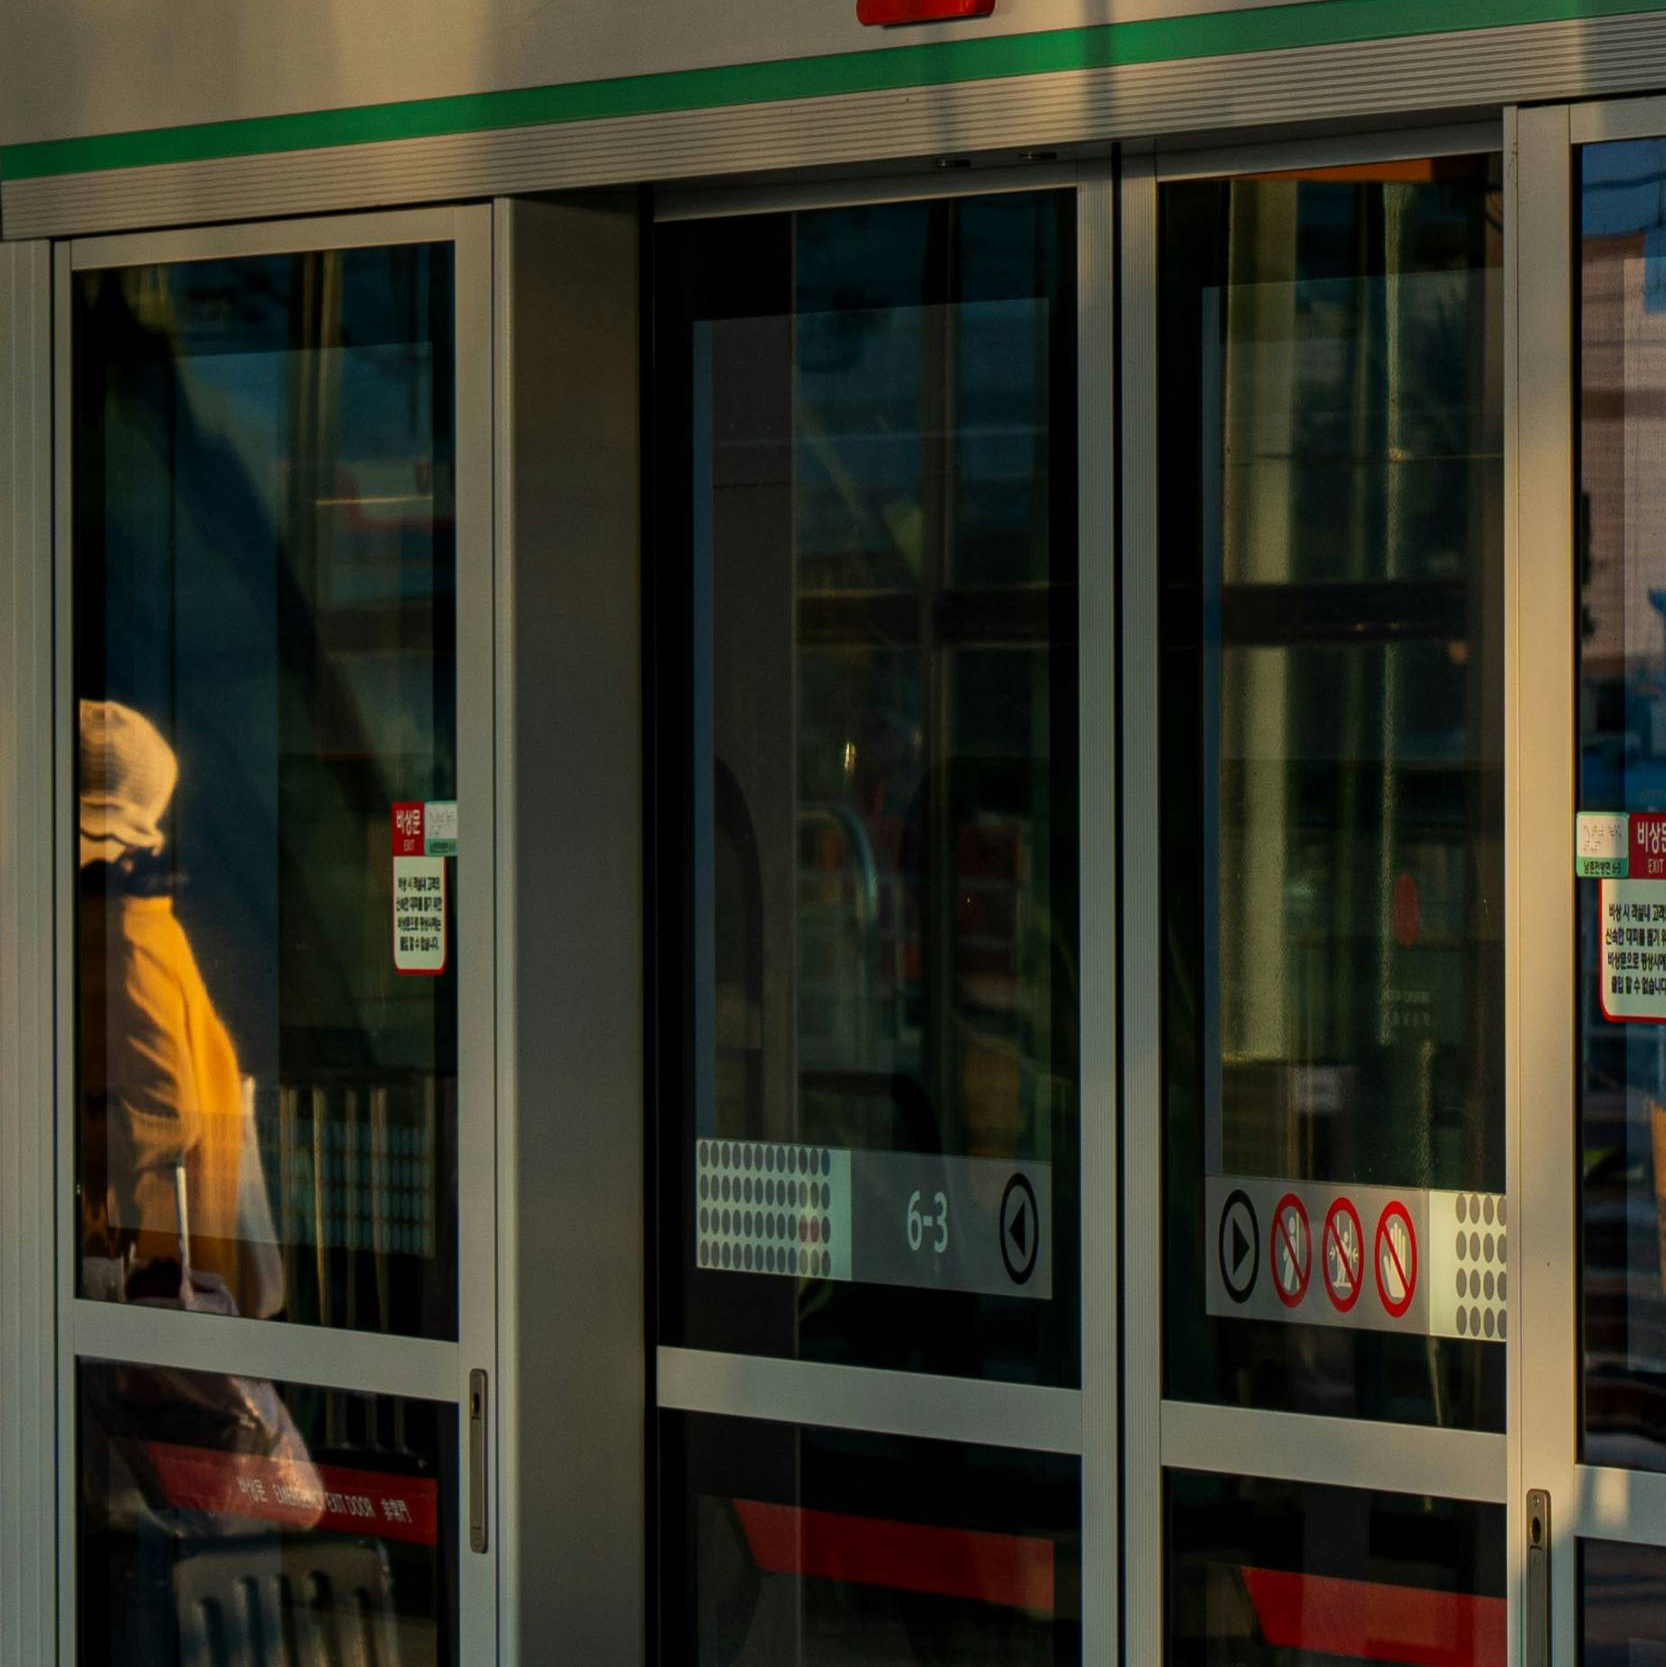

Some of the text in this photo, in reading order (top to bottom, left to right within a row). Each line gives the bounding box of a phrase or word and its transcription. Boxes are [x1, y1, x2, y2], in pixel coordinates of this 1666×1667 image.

[1647, 857, 1665, 875] EXIT
[907, 1189, 949, 1254] 6-3
[345, 1494, 377, 1518] DOOR
